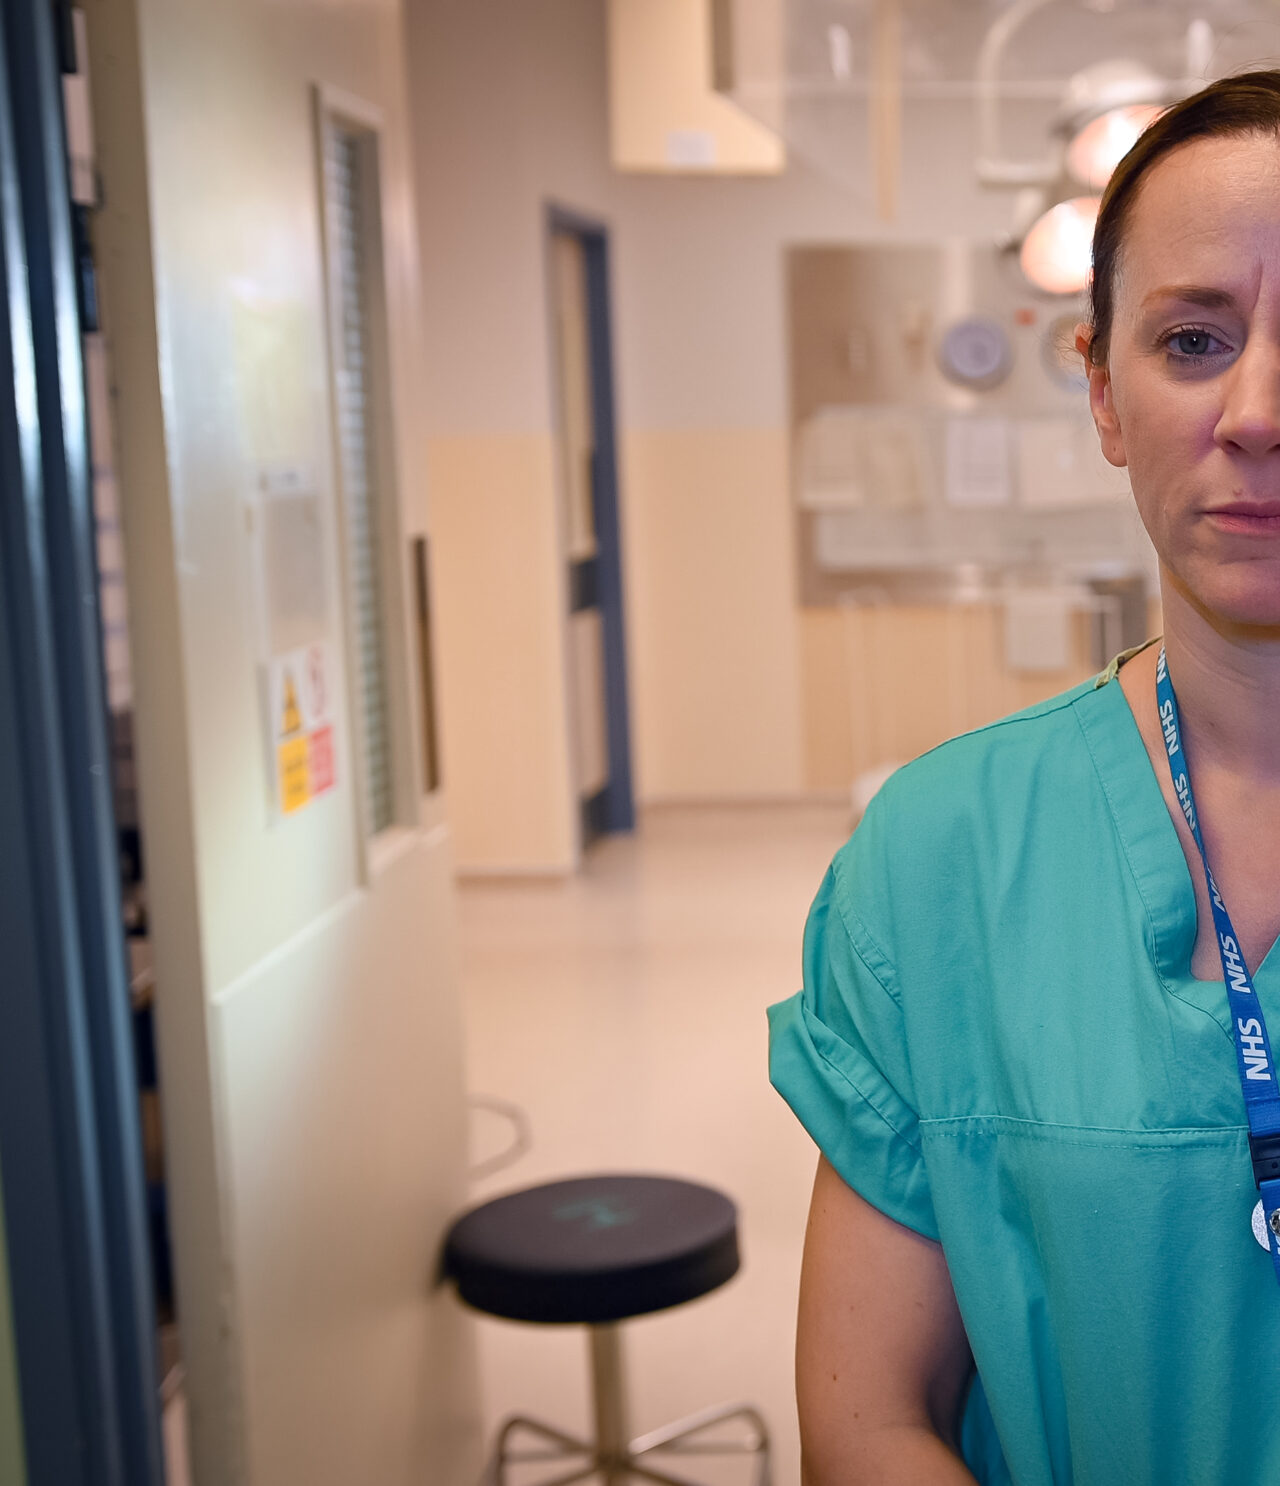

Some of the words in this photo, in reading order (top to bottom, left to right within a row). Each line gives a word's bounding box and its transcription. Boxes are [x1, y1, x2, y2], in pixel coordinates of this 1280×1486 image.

[1159, 699, 1179, 756] NHS
[1175, 773, 1196, 830] NHS
[1220, 932, 1251, 993] NHS
[1237, 1017, 1272, 1081] NHS
